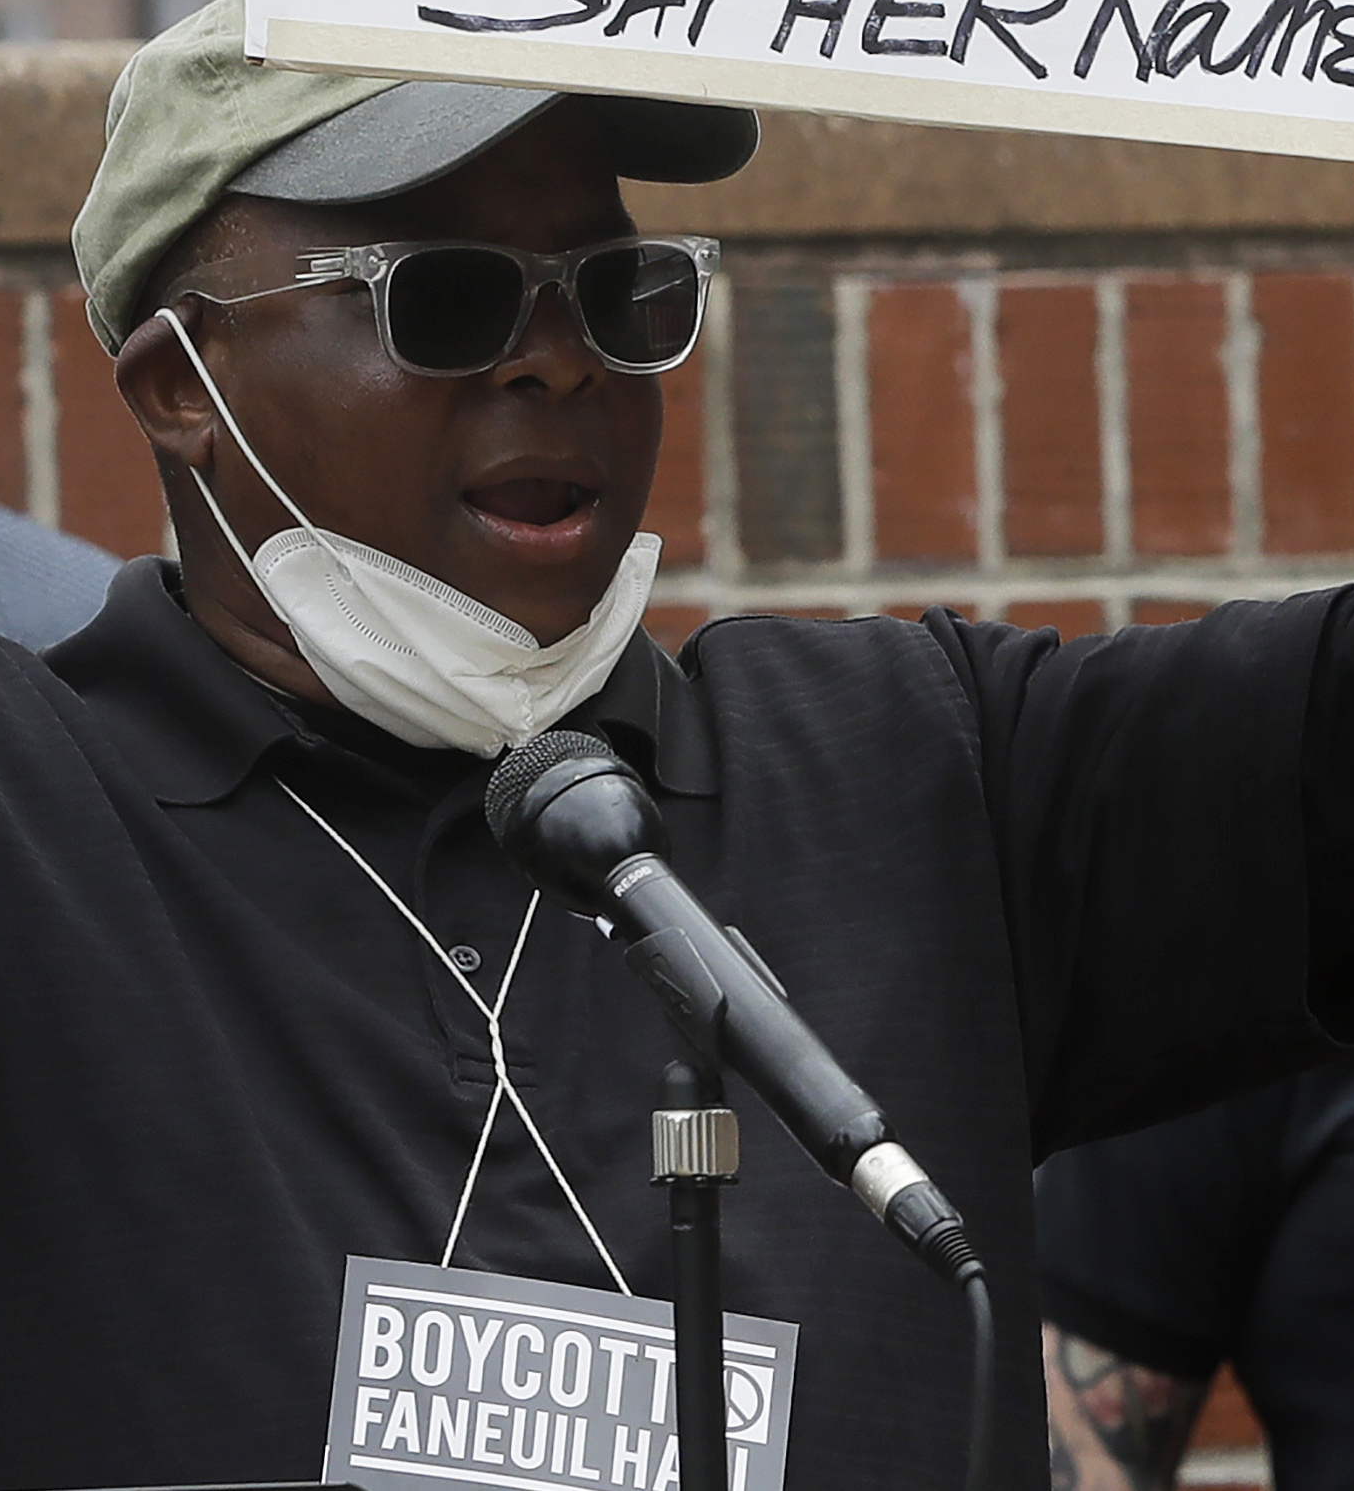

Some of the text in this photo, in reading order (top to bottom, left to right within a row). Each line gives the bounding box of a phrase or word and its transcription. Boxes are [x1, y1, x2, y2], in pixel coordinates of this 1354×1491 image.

[358, 1302, 677, 1424] BOYCOTT
[351, 1385, 750, 1491] FANEUIL HAL
